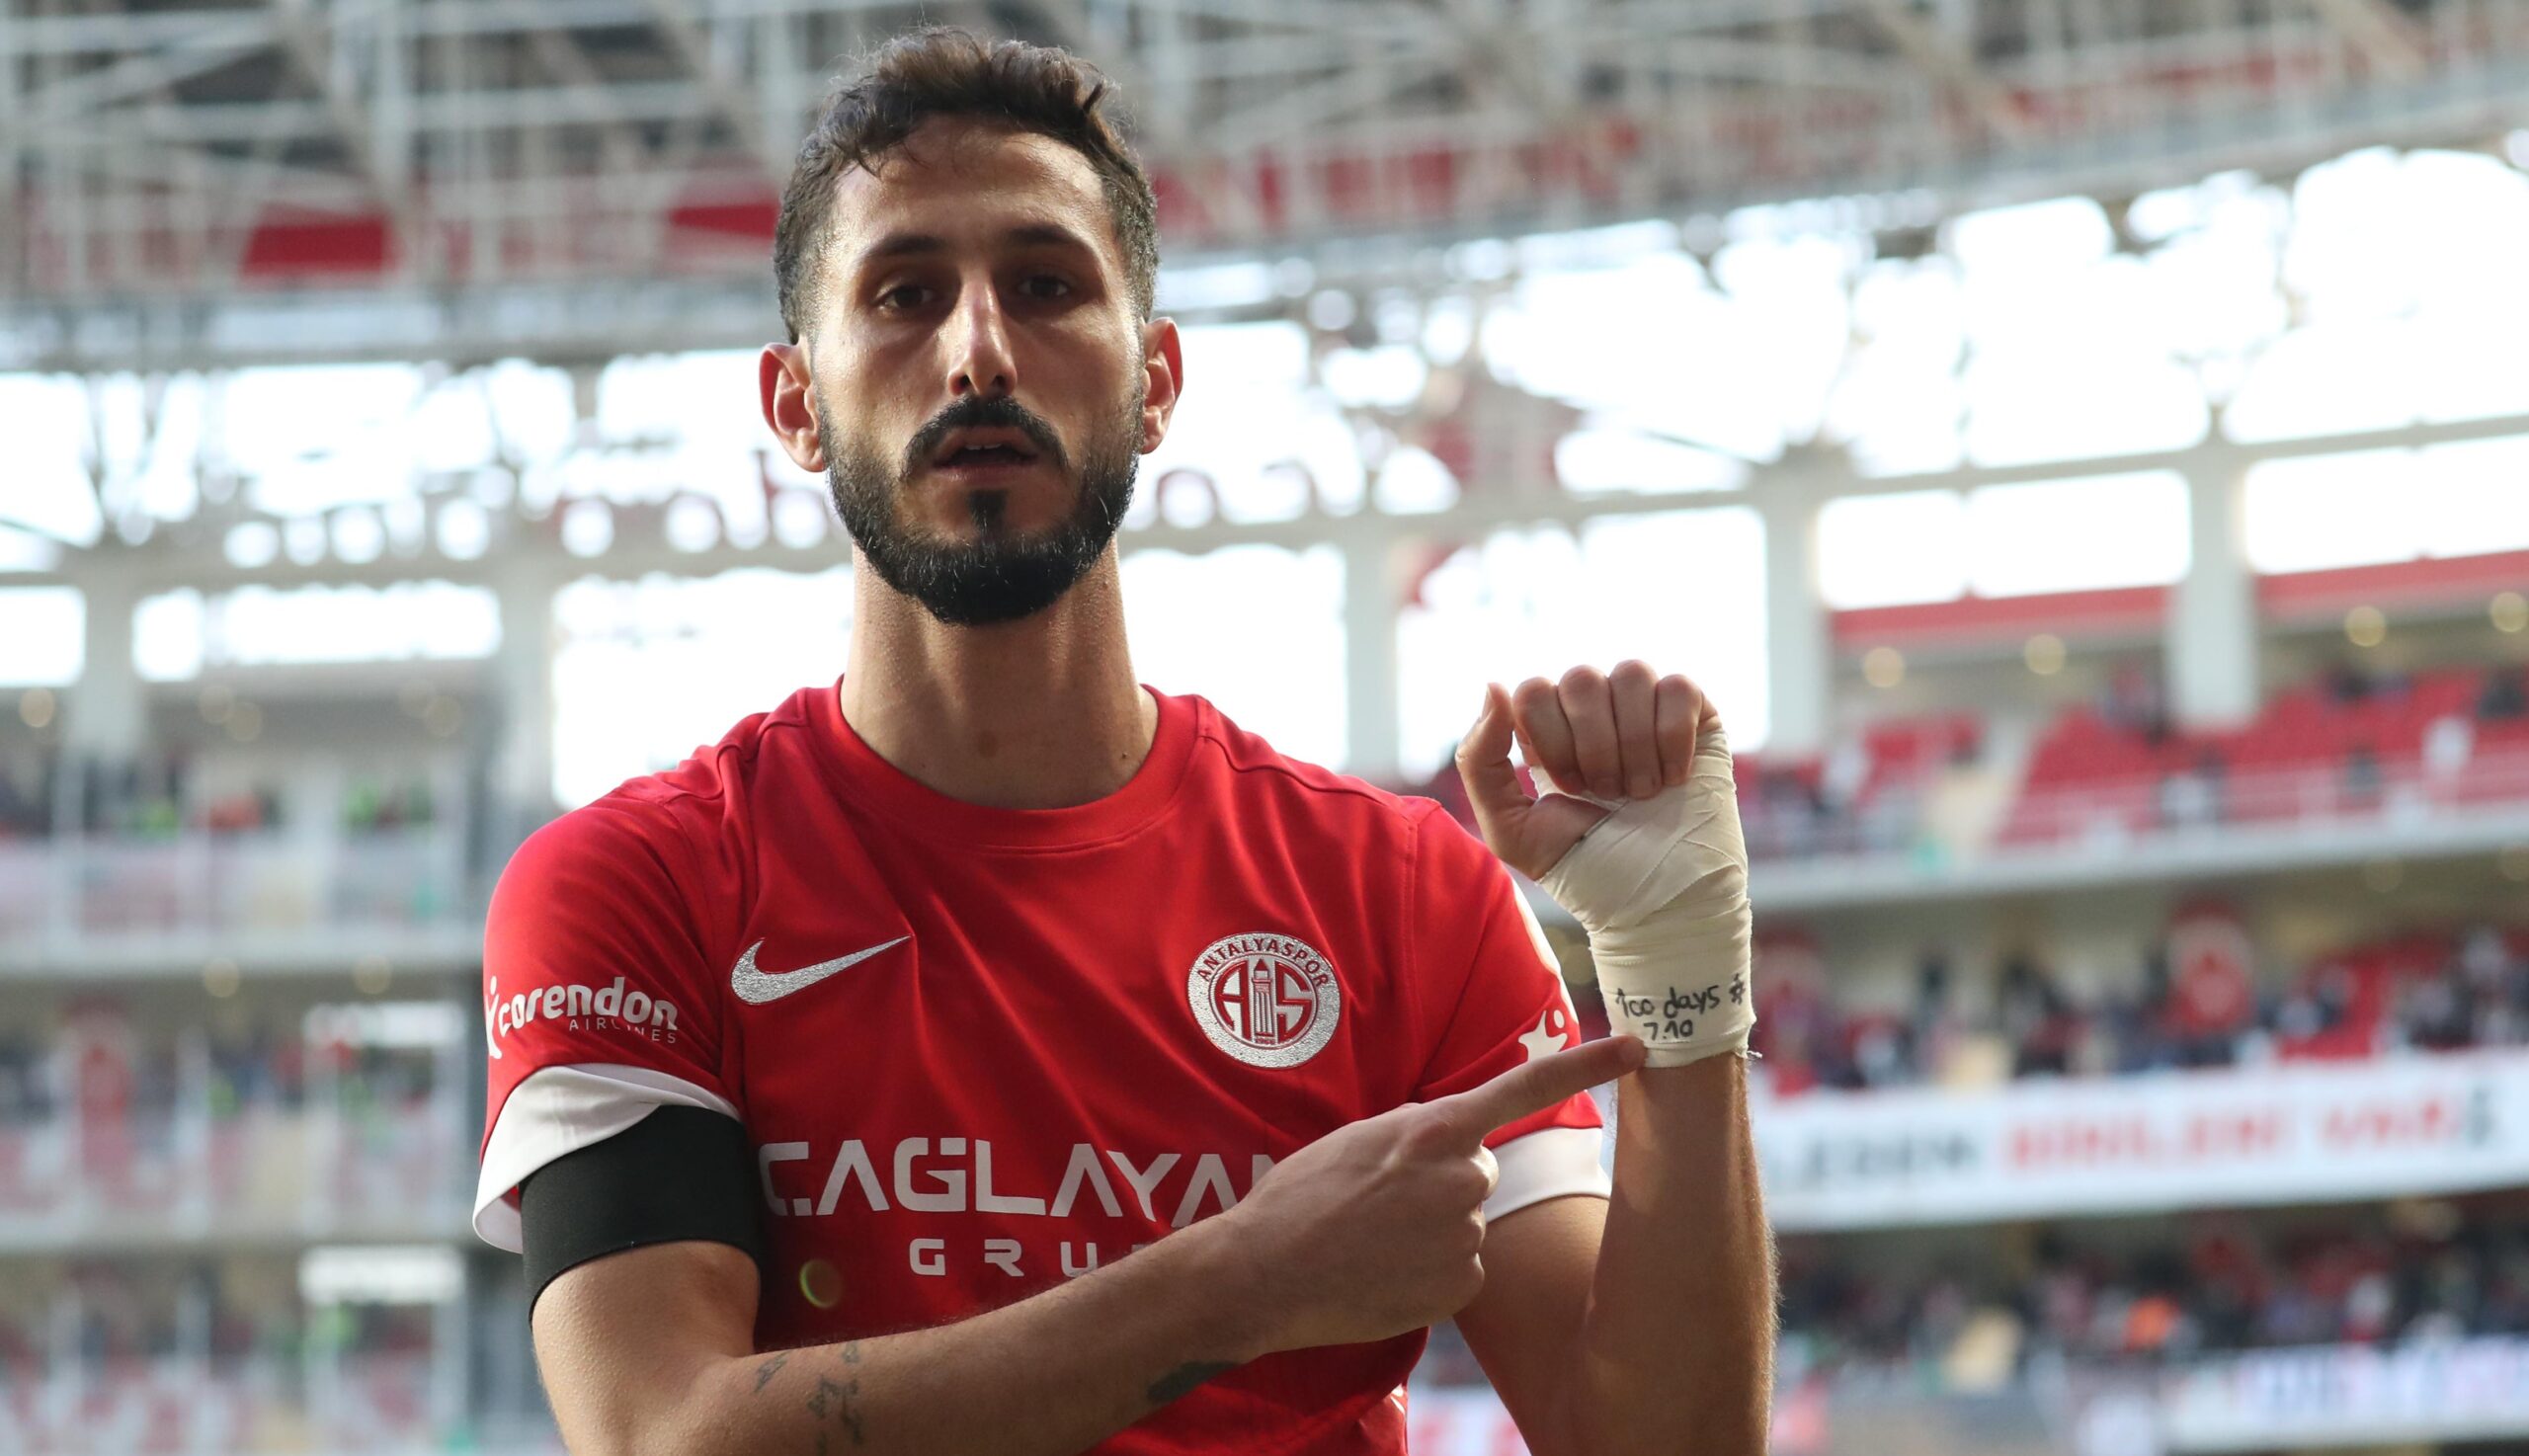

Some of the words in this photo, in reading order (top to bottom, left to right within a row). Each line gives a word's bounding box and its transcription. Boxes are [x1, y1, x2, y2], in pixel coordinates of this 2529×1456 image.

[1197, 937, 1329, 987] ANTALYASPOR
[498, 976, 679, 1038] corendon
[1664, 984, 1721, 1019] days
[1643, 1019, 1693, 1040] 7.10
[909, 1238, 1149, 1278] GRU
